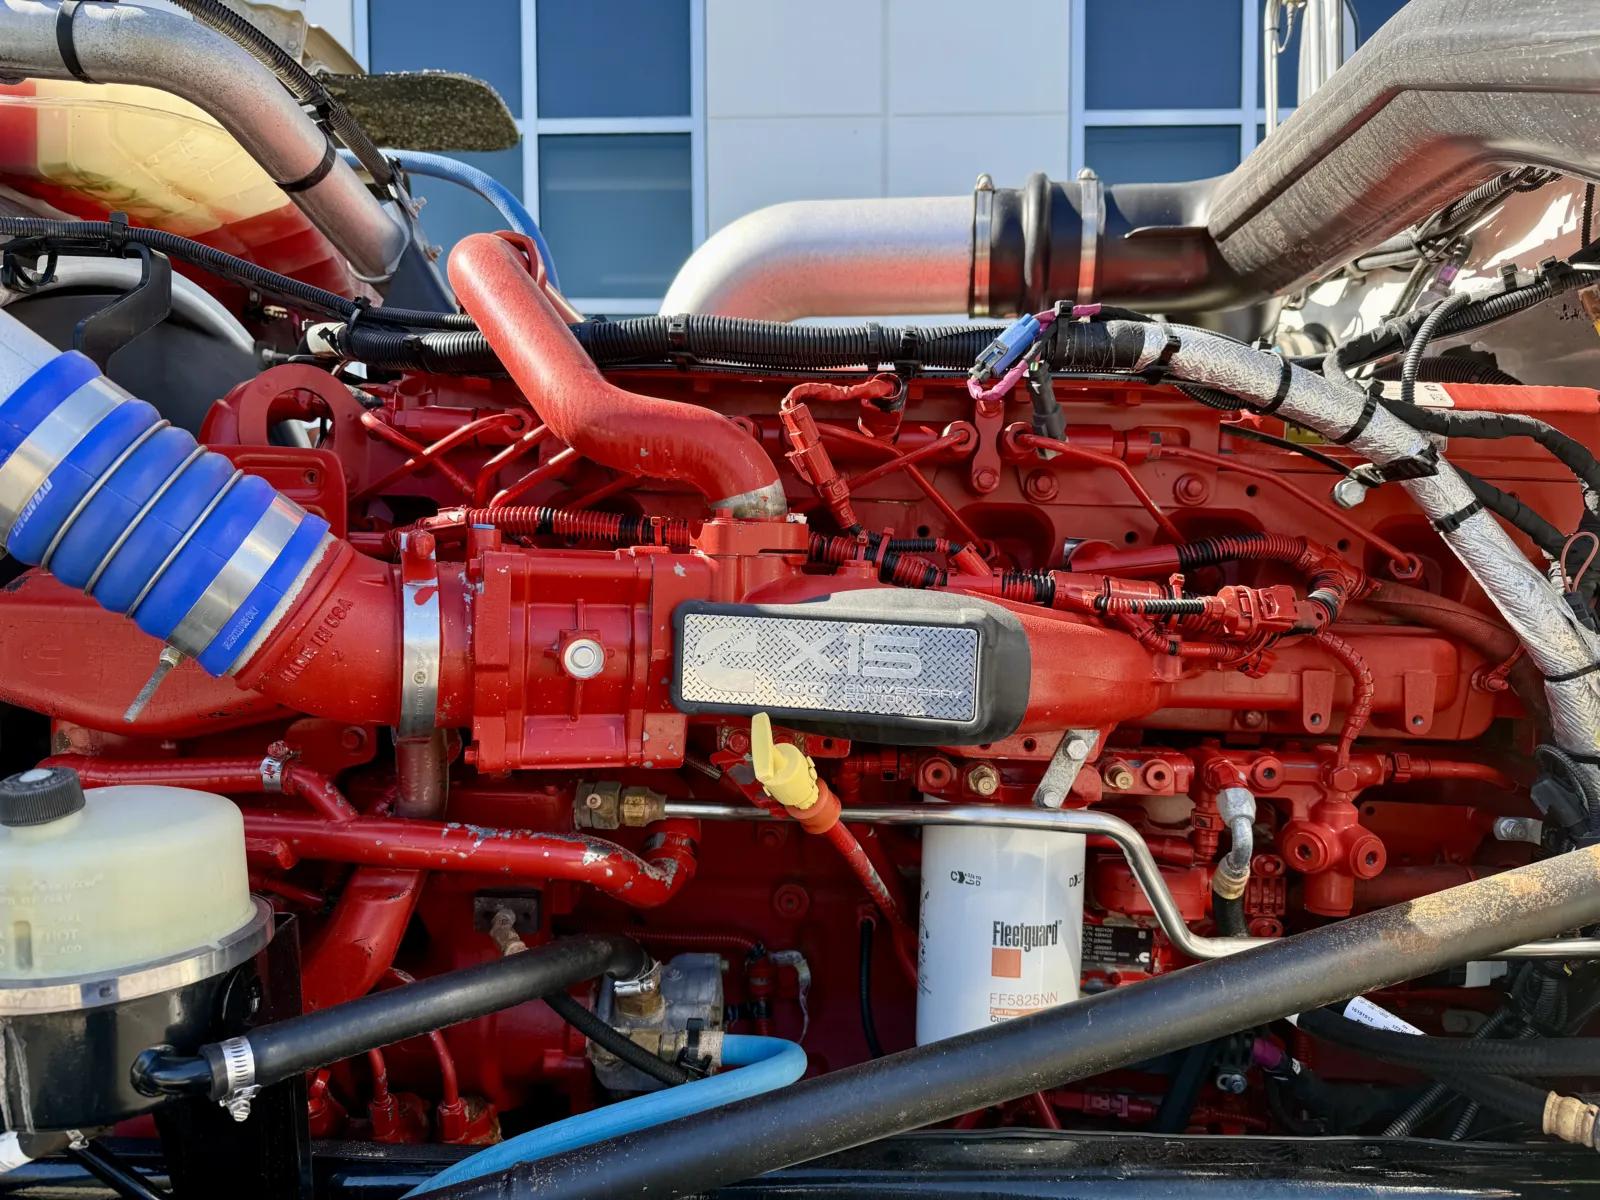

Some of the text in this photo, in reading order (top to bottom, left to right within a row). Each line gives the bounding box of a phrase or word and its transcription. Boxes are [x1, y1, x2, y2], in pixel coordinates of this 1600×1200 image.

[280, 598, 353, 682] MADE IN USA
[780, 630, 922, 680] X15
[845, 683, 963, 699] ANNIVERSARY
[845, 693, 908, 703] EDITION
[992, 920, 1058, 952] Fleetguard
[990, 992, 1058, 1006] FF5825NN
